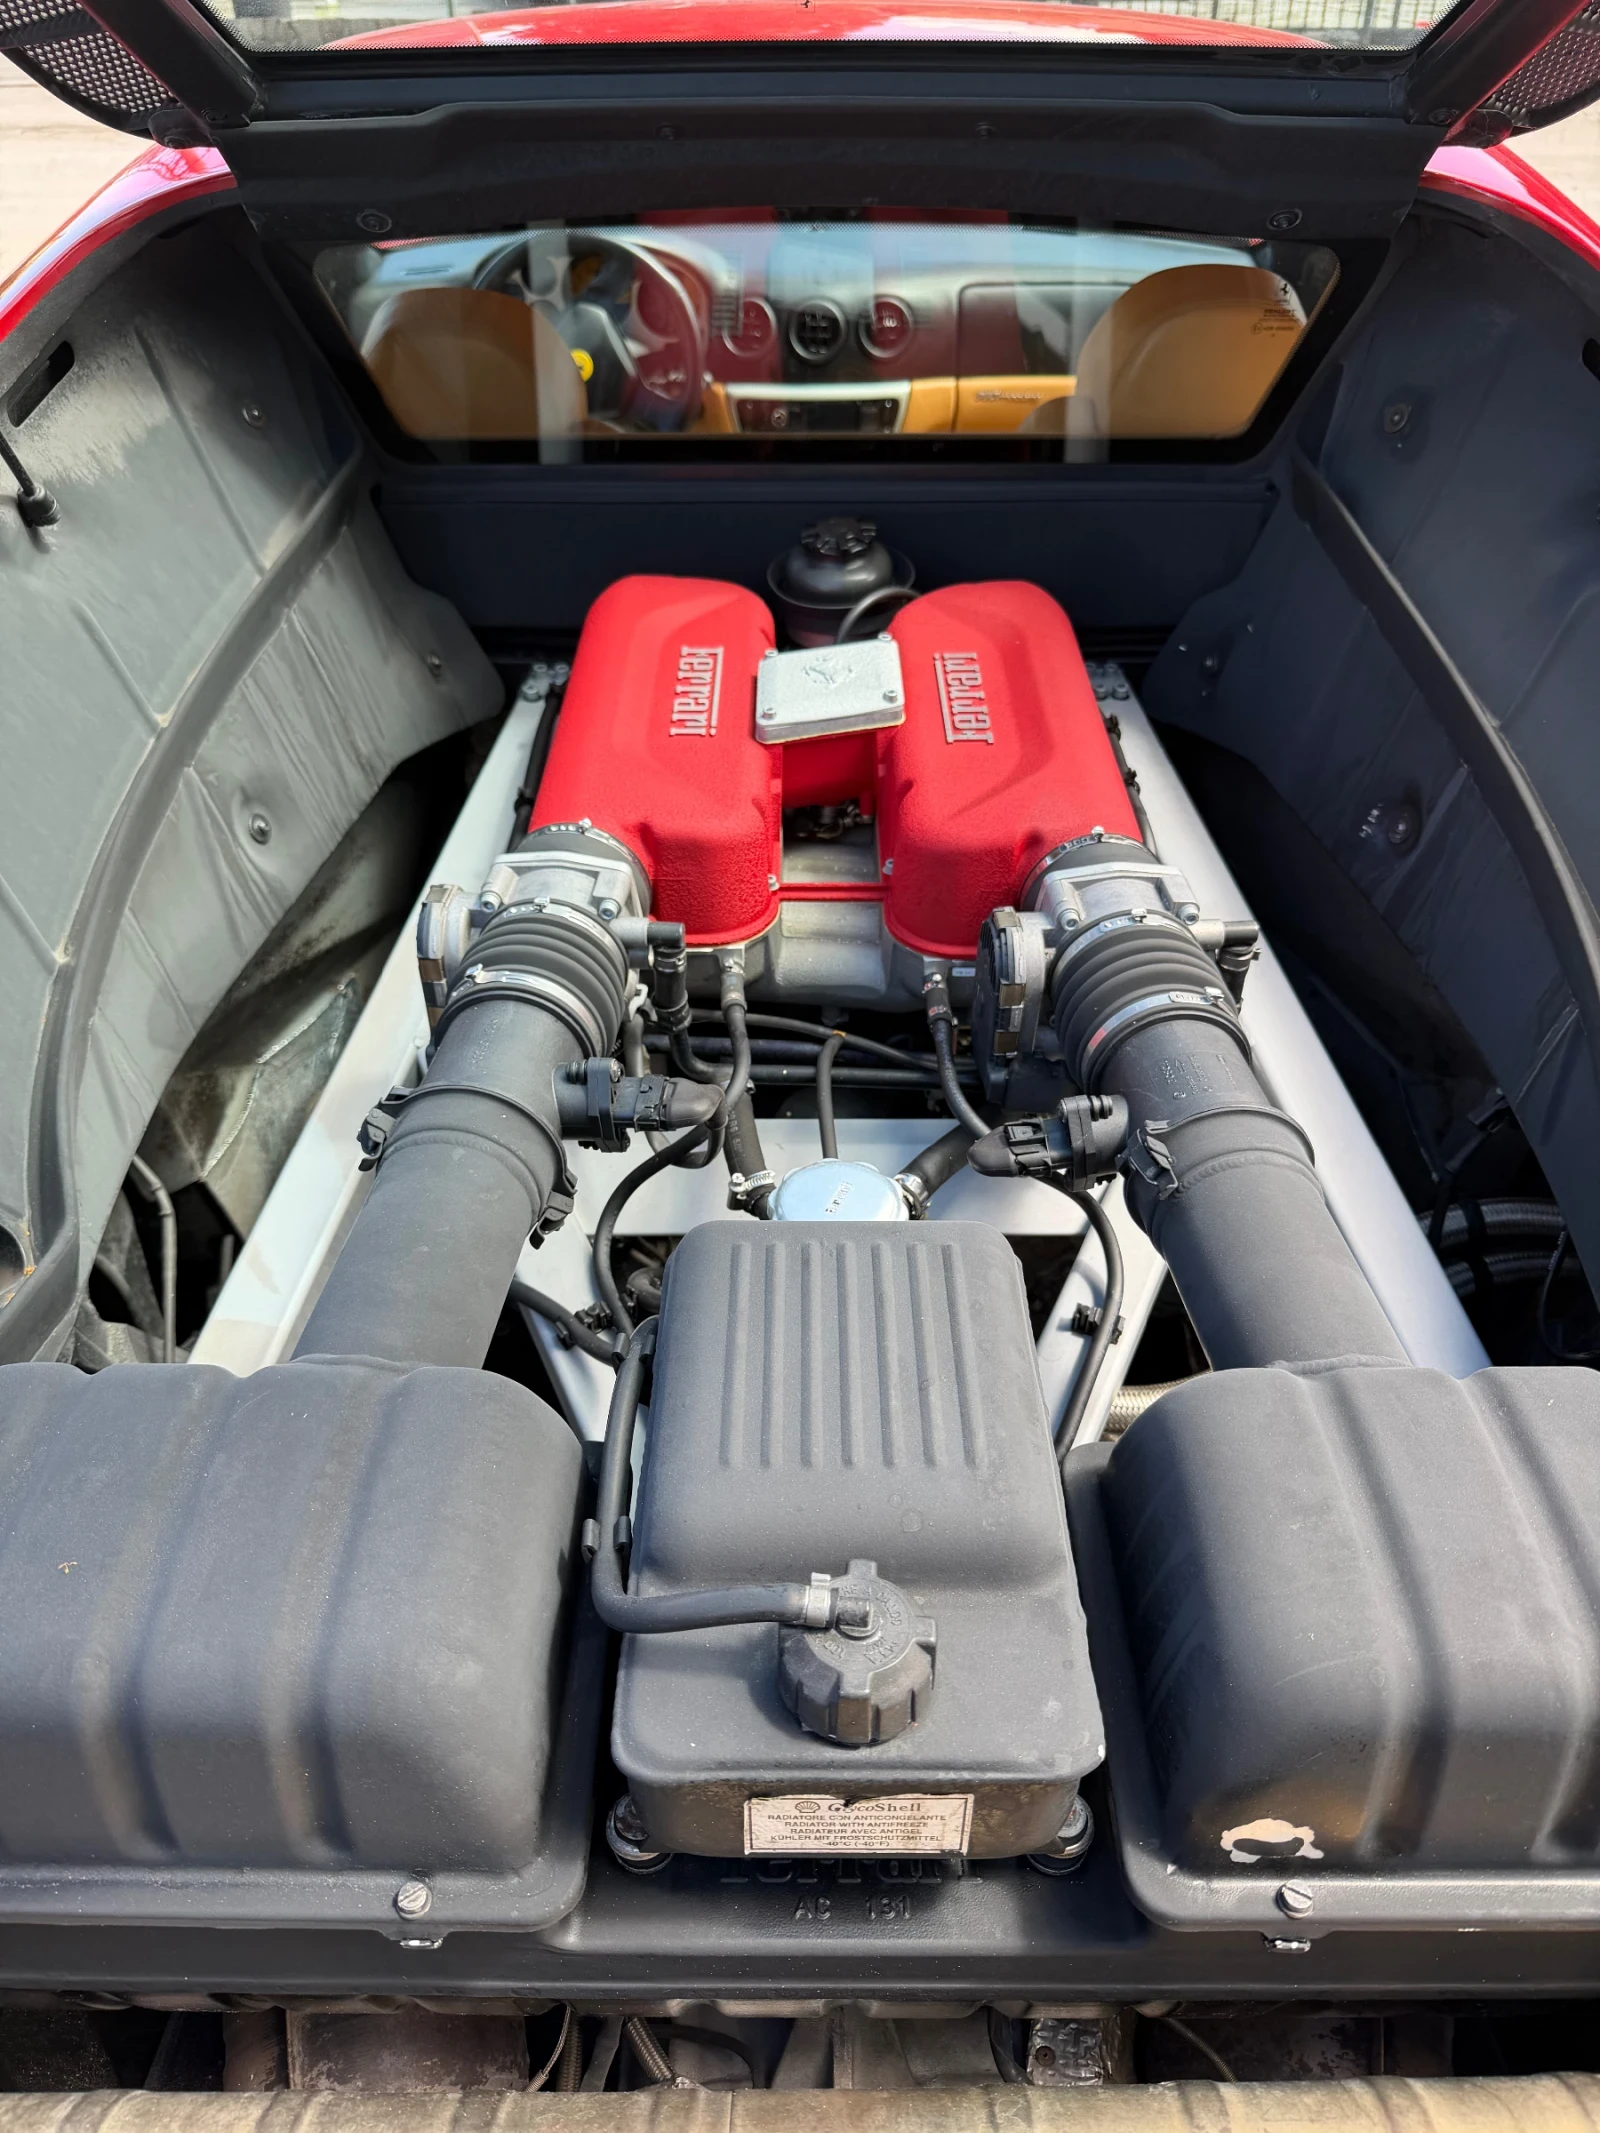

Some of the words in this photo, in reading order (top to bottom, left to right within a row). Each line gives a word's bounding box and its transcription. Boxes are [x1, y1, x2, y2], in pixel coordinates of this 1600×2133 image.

[670, 645, 724, 737] Ferrari
[934, 652, 993, 743] Ferrari
[795, 1897, 832, 1920] AC
